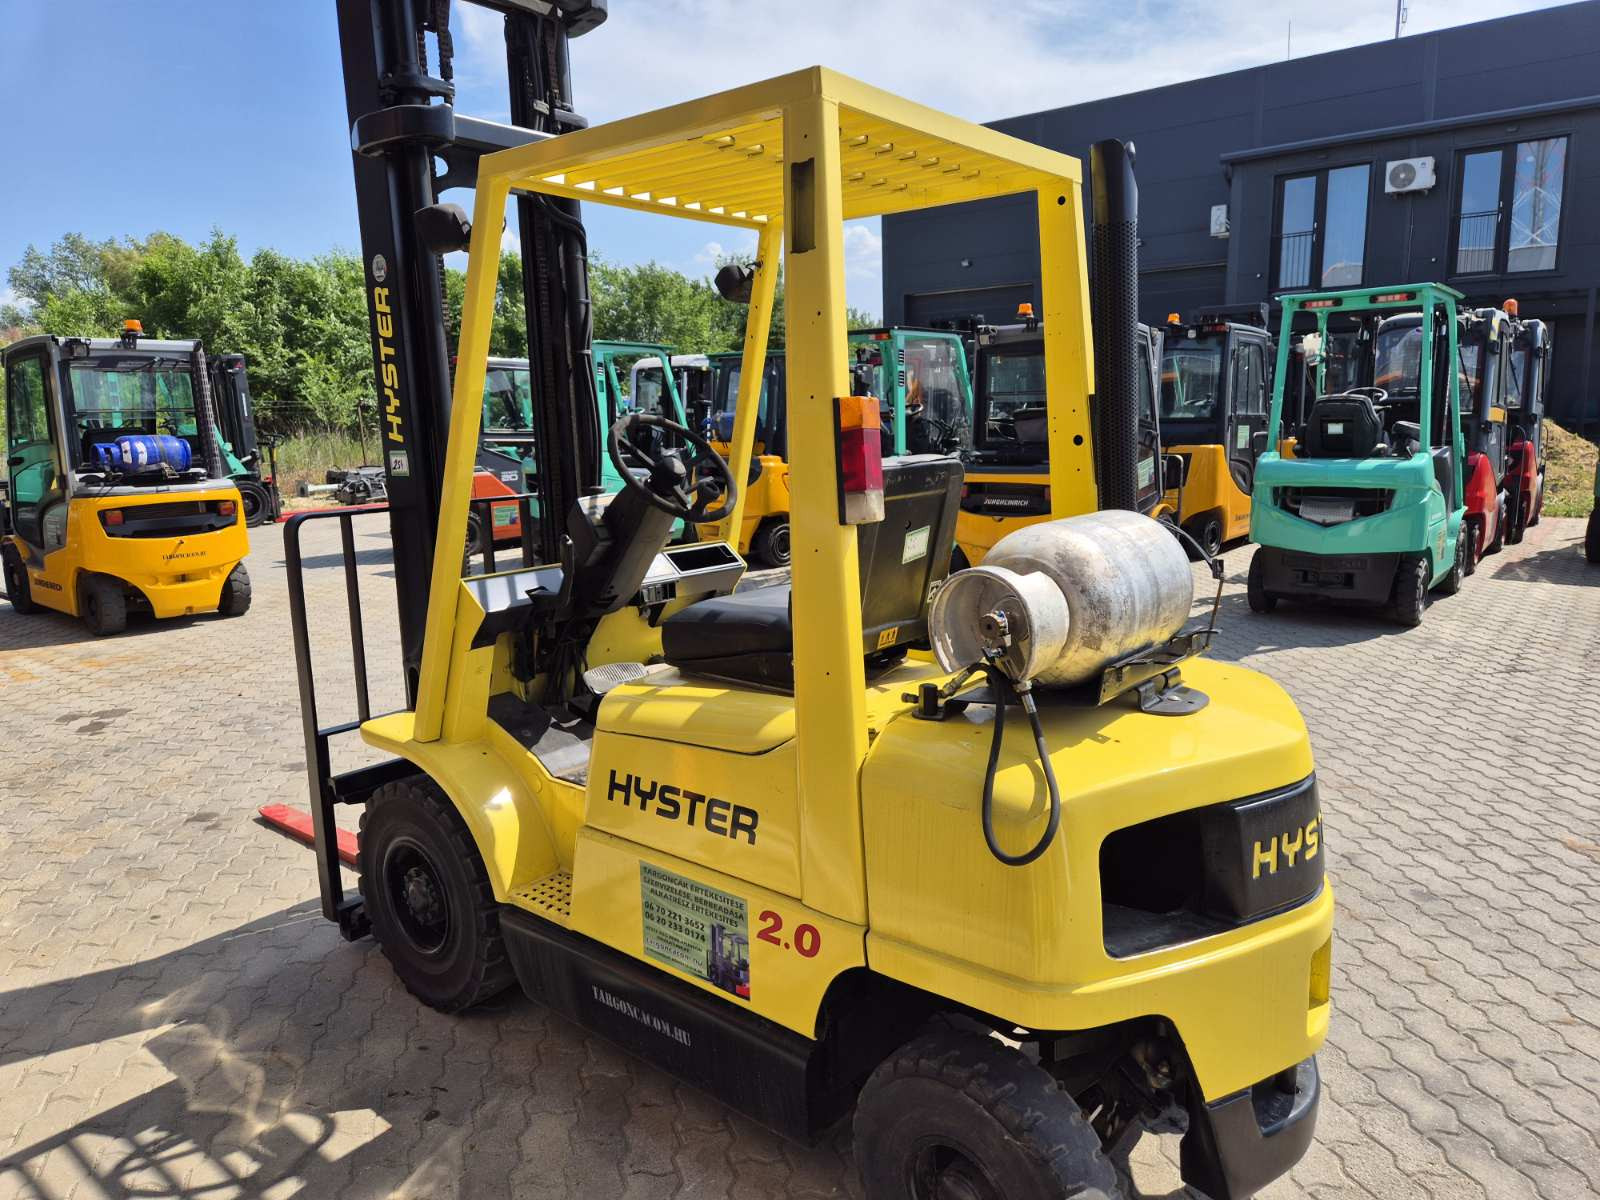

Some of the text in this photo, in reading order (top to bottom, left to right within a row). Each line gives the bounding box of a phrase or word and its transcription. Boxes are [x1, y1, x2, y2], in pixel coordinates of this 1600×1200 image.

[374, 287, 404, 443] HYSTER
[607, 769, 759, 845] HYSTER
[644, 901, 705, 932] 06 70 221 3652
[644, 911, 706, 942] 06 20 233 0174
[756, 910, 821, 958] 2.0
